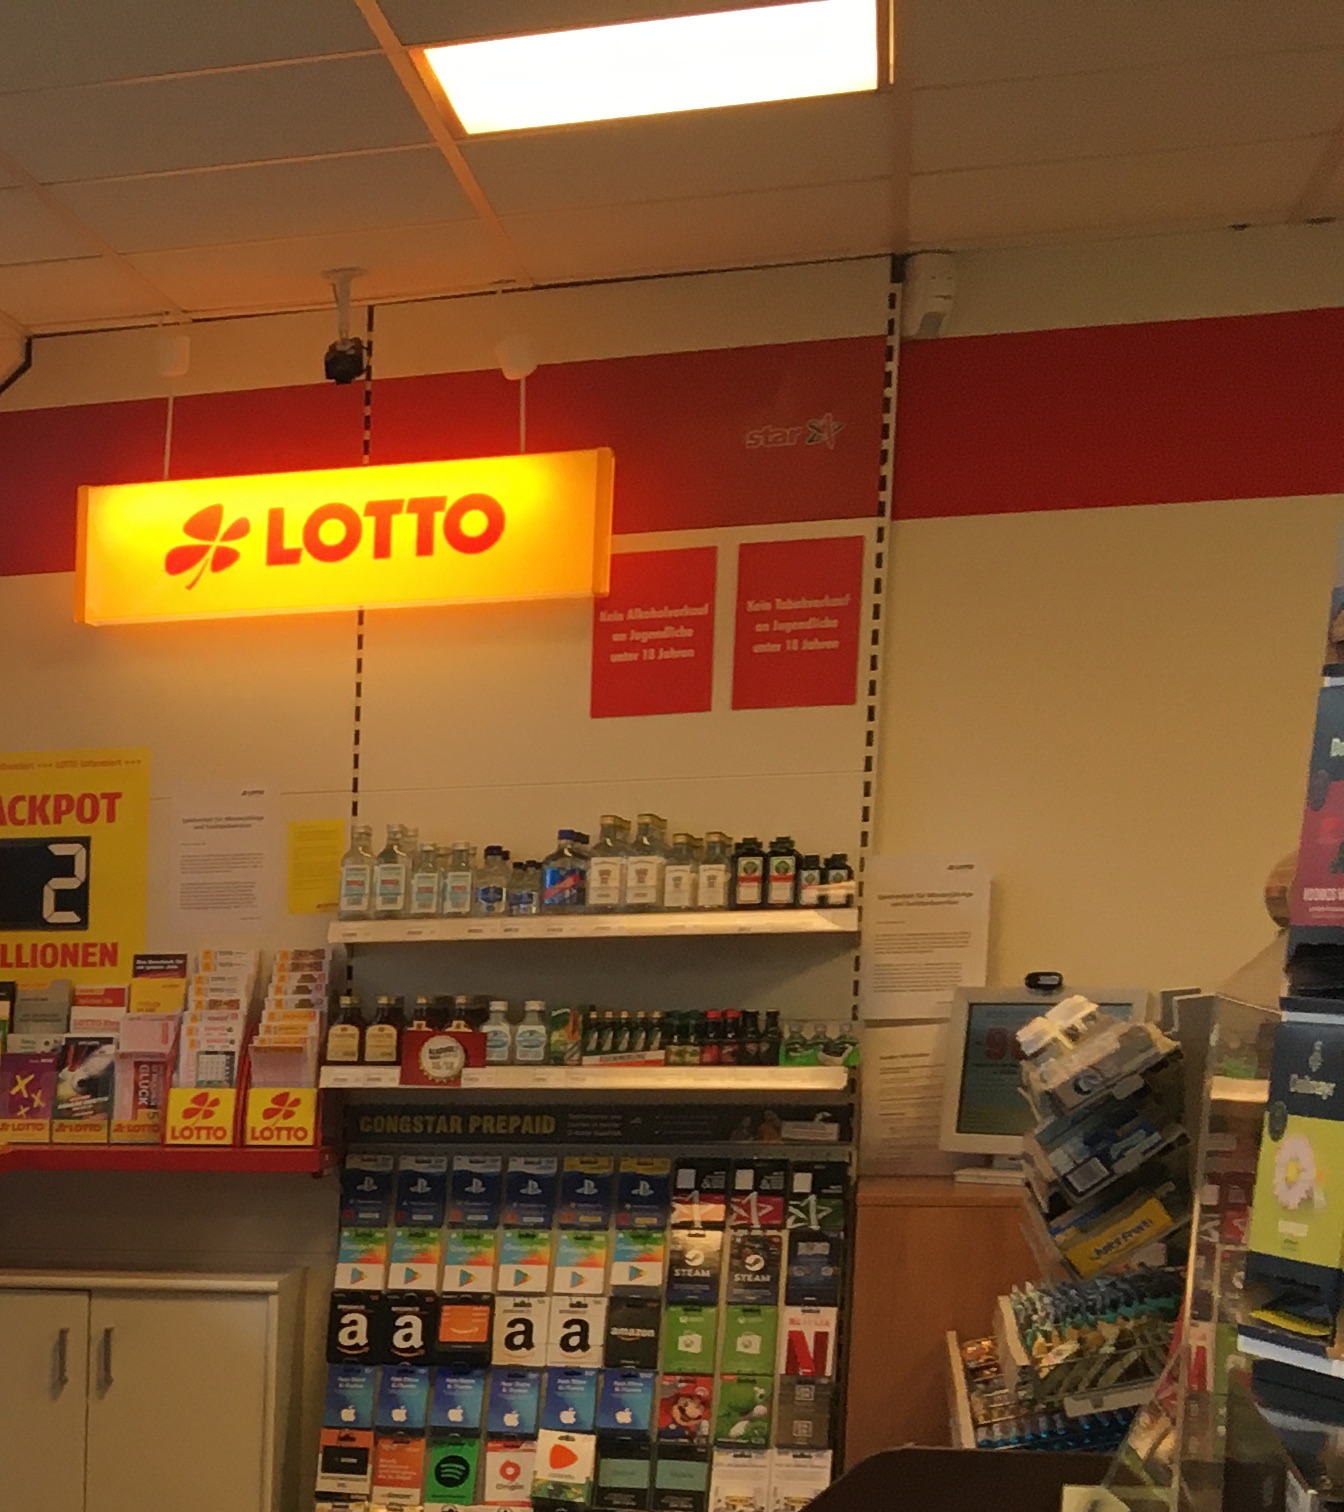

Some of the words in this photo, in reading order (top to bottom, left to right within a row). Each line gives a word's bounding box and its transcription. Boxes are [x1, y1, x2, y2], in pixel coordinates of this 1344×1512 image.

[745, 425, 800, 449] star
[266, 493, 505, 567] LOTTO
[772, 617, 839, 633] Jugendliche
[629, 625, 694, 643] Jugendliche
[785, 639, 798, 650] 18
[642, 649, 655, 660] 18
[43, 843, 86, 923] 2
[12, 1122, 44, 1131] LOTTO
[69, 1123, 101, 1132] LOTTO
[127, 1123, 160, 1132] LOTTO
[360, 1114, 463, 1134] CONGSTAR
[469, 1113, 556, 1135] PREPAID
[170, 1126, 227, 1141] LOTTO
[250, 1126, 308, 1142] LOTTO
[674, 1268, 710, 1277] STEAM
[734, 1273, 771, 1282] STEAM
